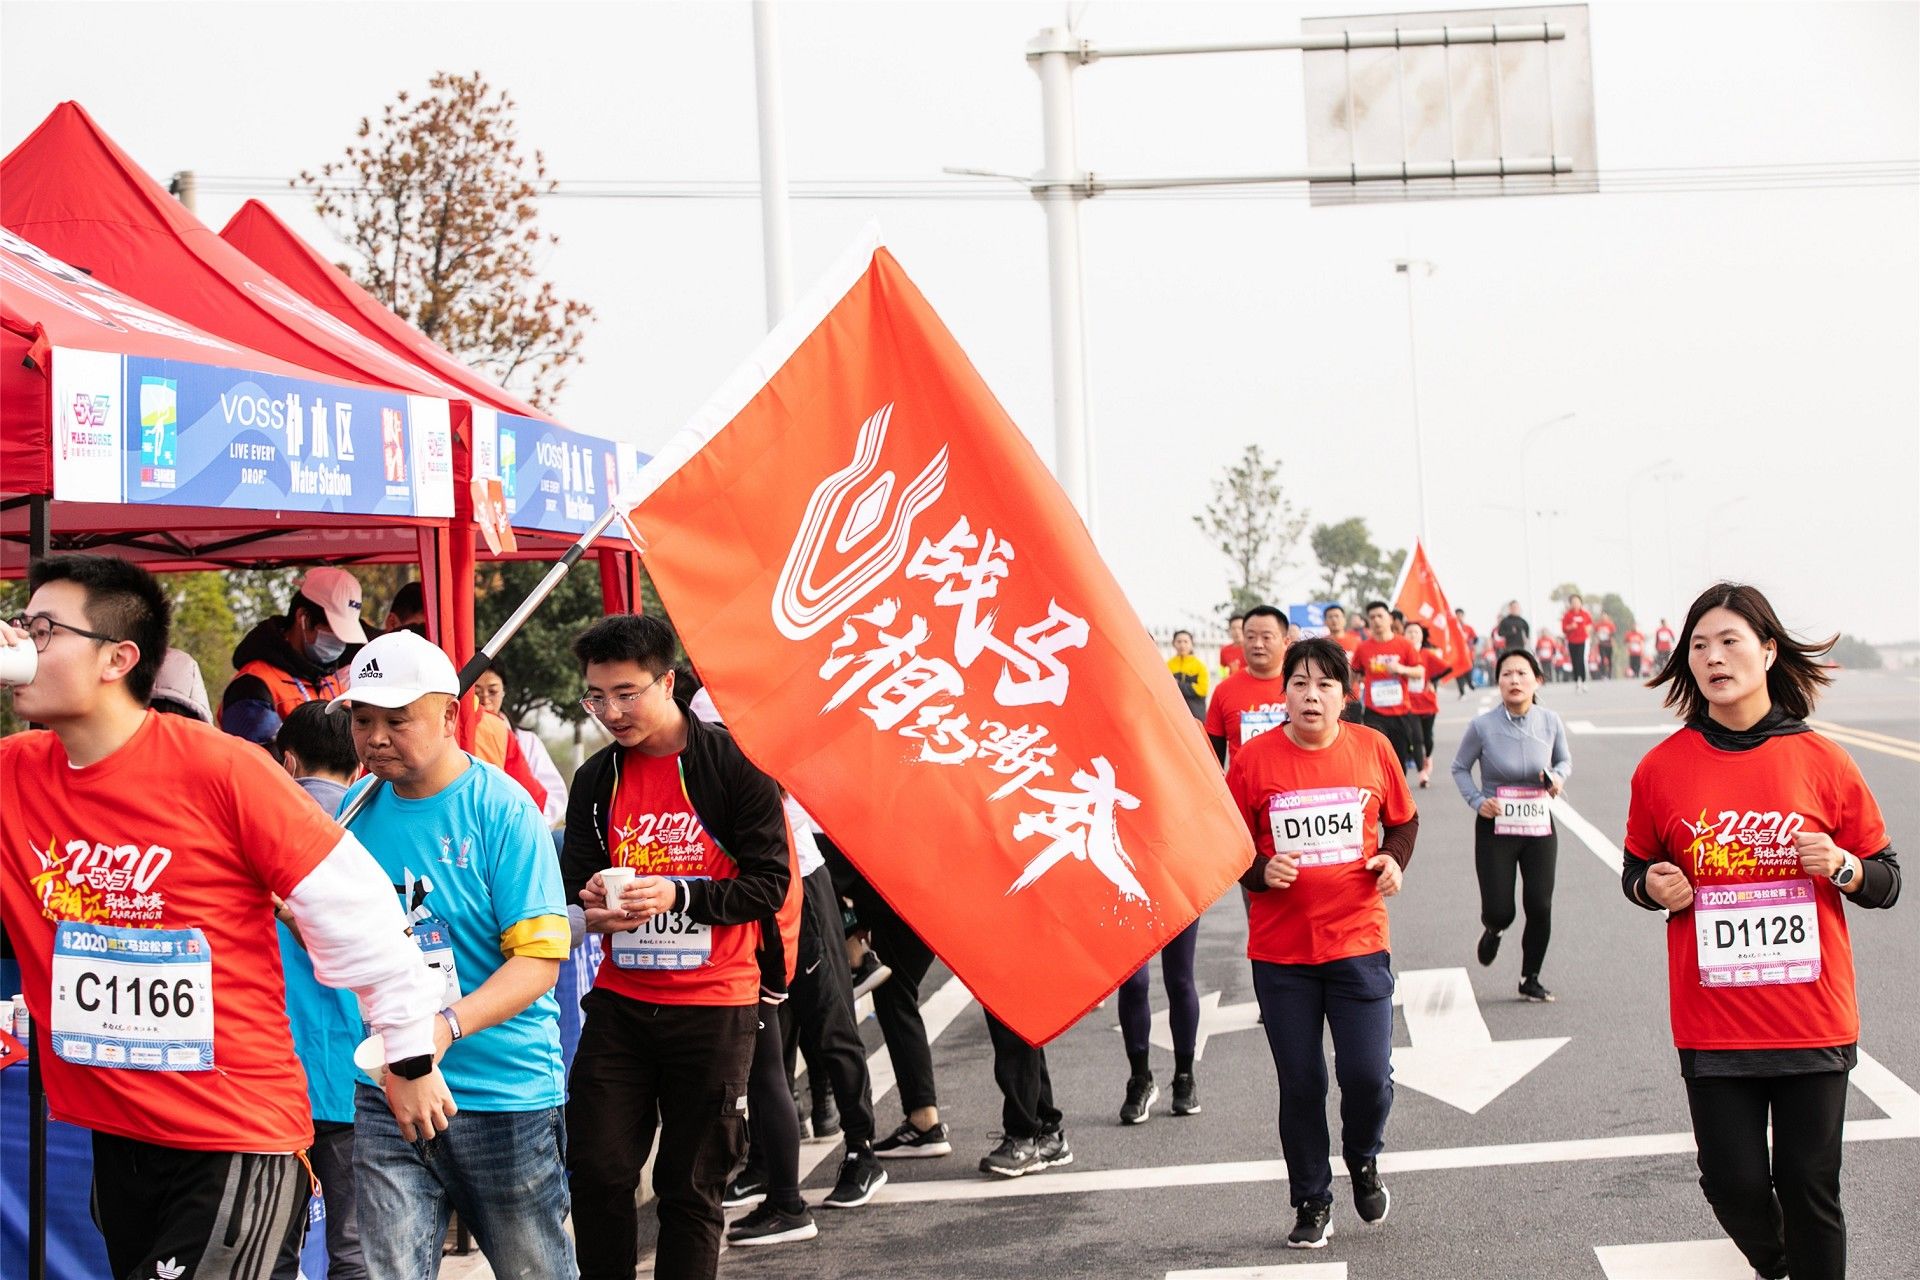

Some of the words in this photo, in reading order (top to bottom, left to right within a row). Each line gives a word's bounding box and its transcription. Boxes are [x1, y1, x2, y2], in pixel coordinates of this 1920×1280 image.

[220, 393, 284, 430] VOSS
[230, 442, 249, 460] LIVE
[251, 444, 276, 462] EVERY
[290, 460, 318, 494] Water
[319, 462, 352, 497] Station
[906, 515, 1091, 707] 战马
[358, 670, 383, 679] adidas
[1284, 812, 1353, 839] D1054
[1504, 803, 1545, 817] D1084
[1716, 809, 1805, 846] 2020
[66, 839, 172, 894] 2020
[1704, 841, 1758, 869] 湘江
[1758, 858, 1797, 866] MARATHON
[110, 909, 163, 921] MARATHON
[1715, 914, 1806, 949] D1128
[76, 971, 195, 1018] C1166
